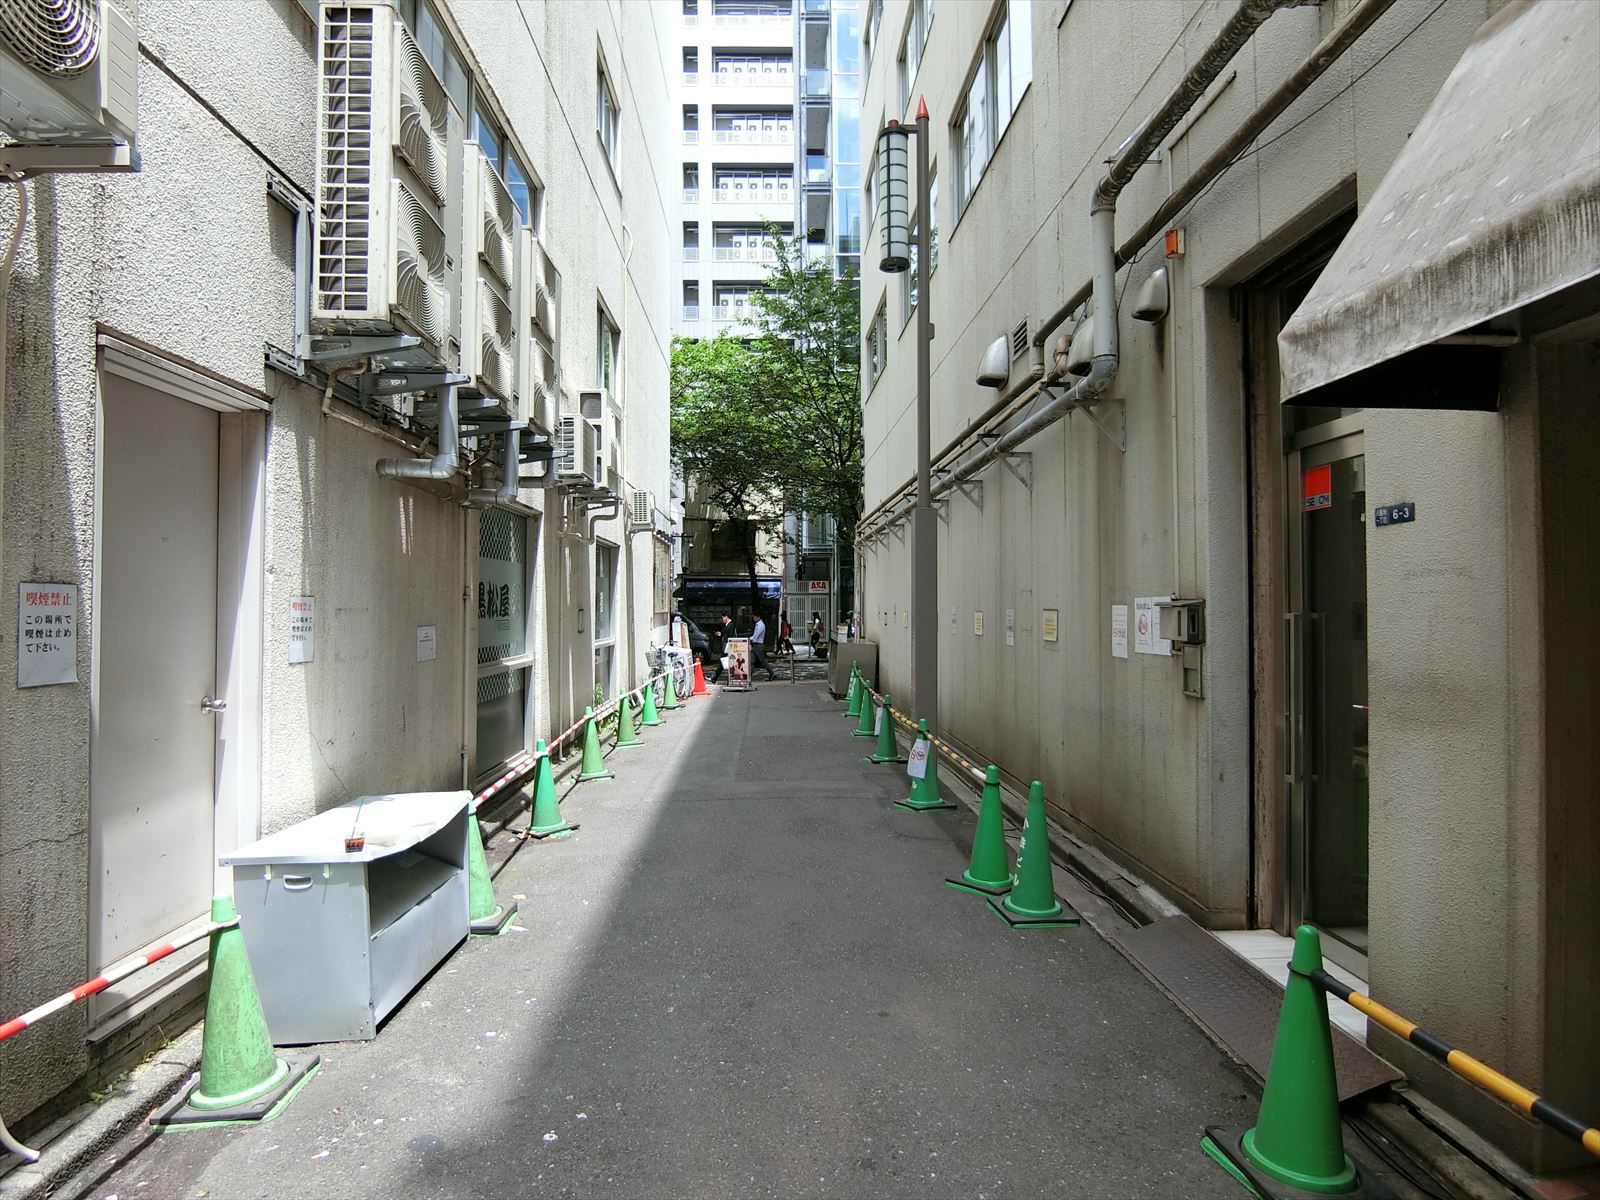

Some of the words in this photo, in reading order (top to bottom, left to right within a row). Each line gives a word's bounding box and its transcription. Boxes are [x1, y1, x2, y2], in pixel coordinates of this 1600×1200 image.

[1392, 507, 1410, 520] 6-3
[811, 581, 827, 590] ASA
[26, 592, 72, 606] 喫煙禁止
[25, 614, 72, 625] この場所で
[25, 628, 72, 639] 喫煙は止め
[25, 642, 61, 653] て下さい。
